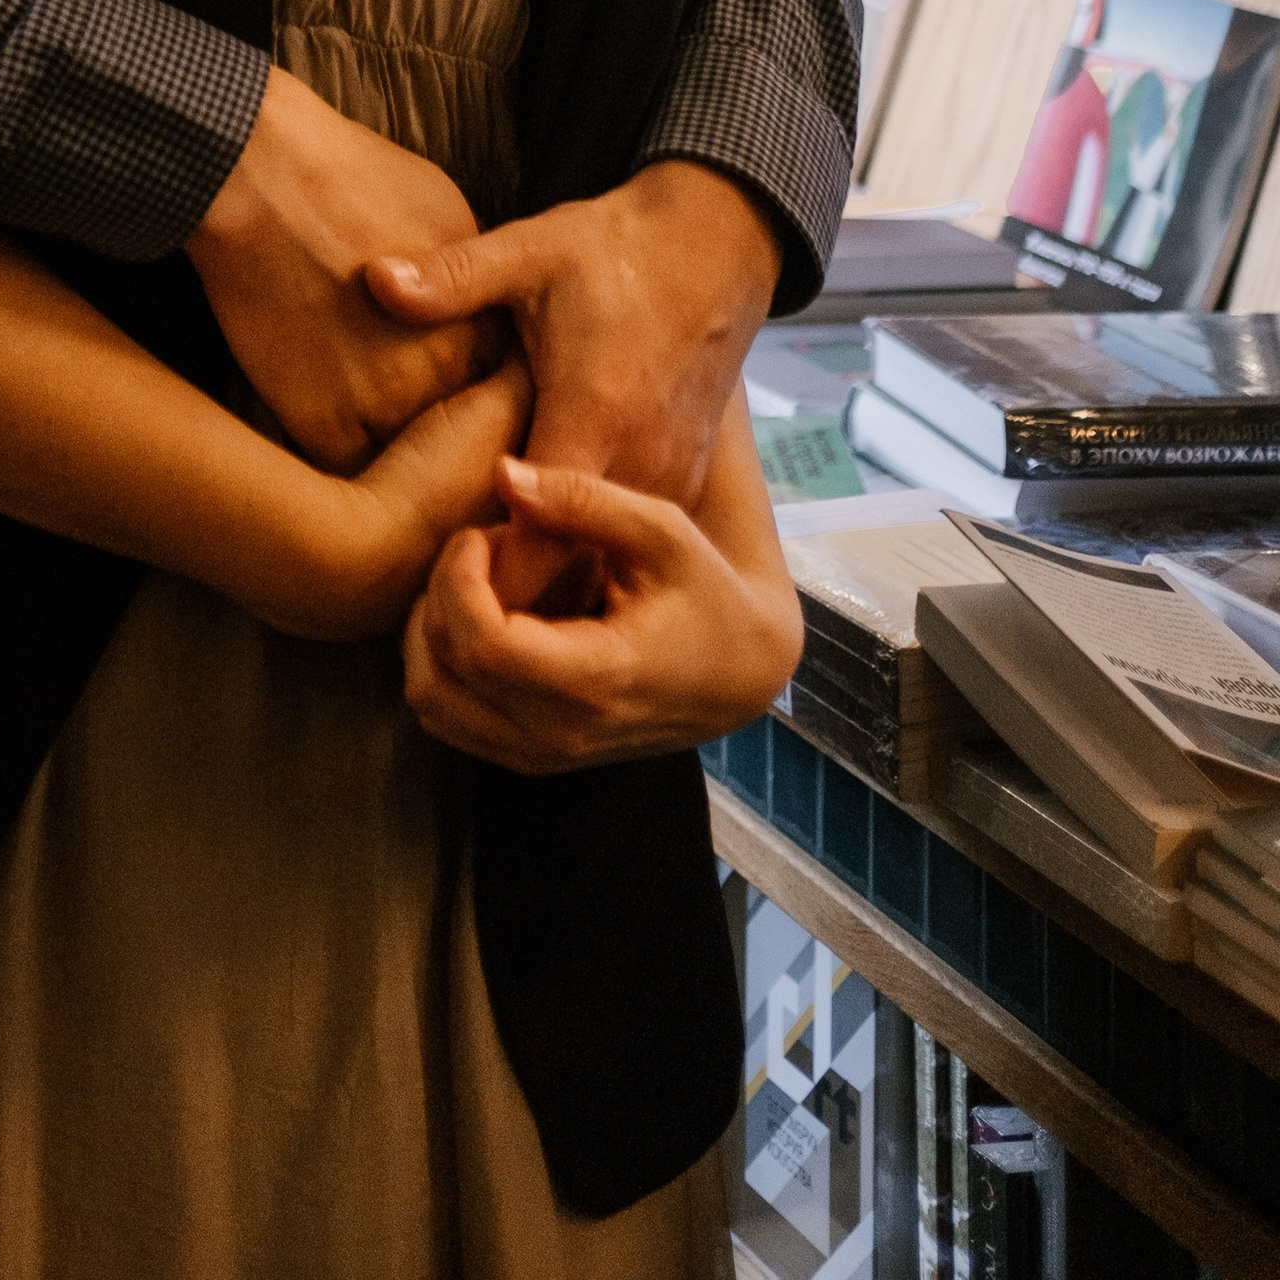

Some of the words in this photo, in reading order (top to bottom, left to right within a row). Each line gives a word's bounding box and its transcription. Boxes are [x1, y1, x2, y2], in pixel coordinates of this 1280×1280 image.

[1070, 424, 1168, 443] ИСТОРИЯ
[1070, 448, 1082, 466] В
[1087, 446, 1161, 467] ЭПОХУ
[1101, 652, 1215, 702] окружении
